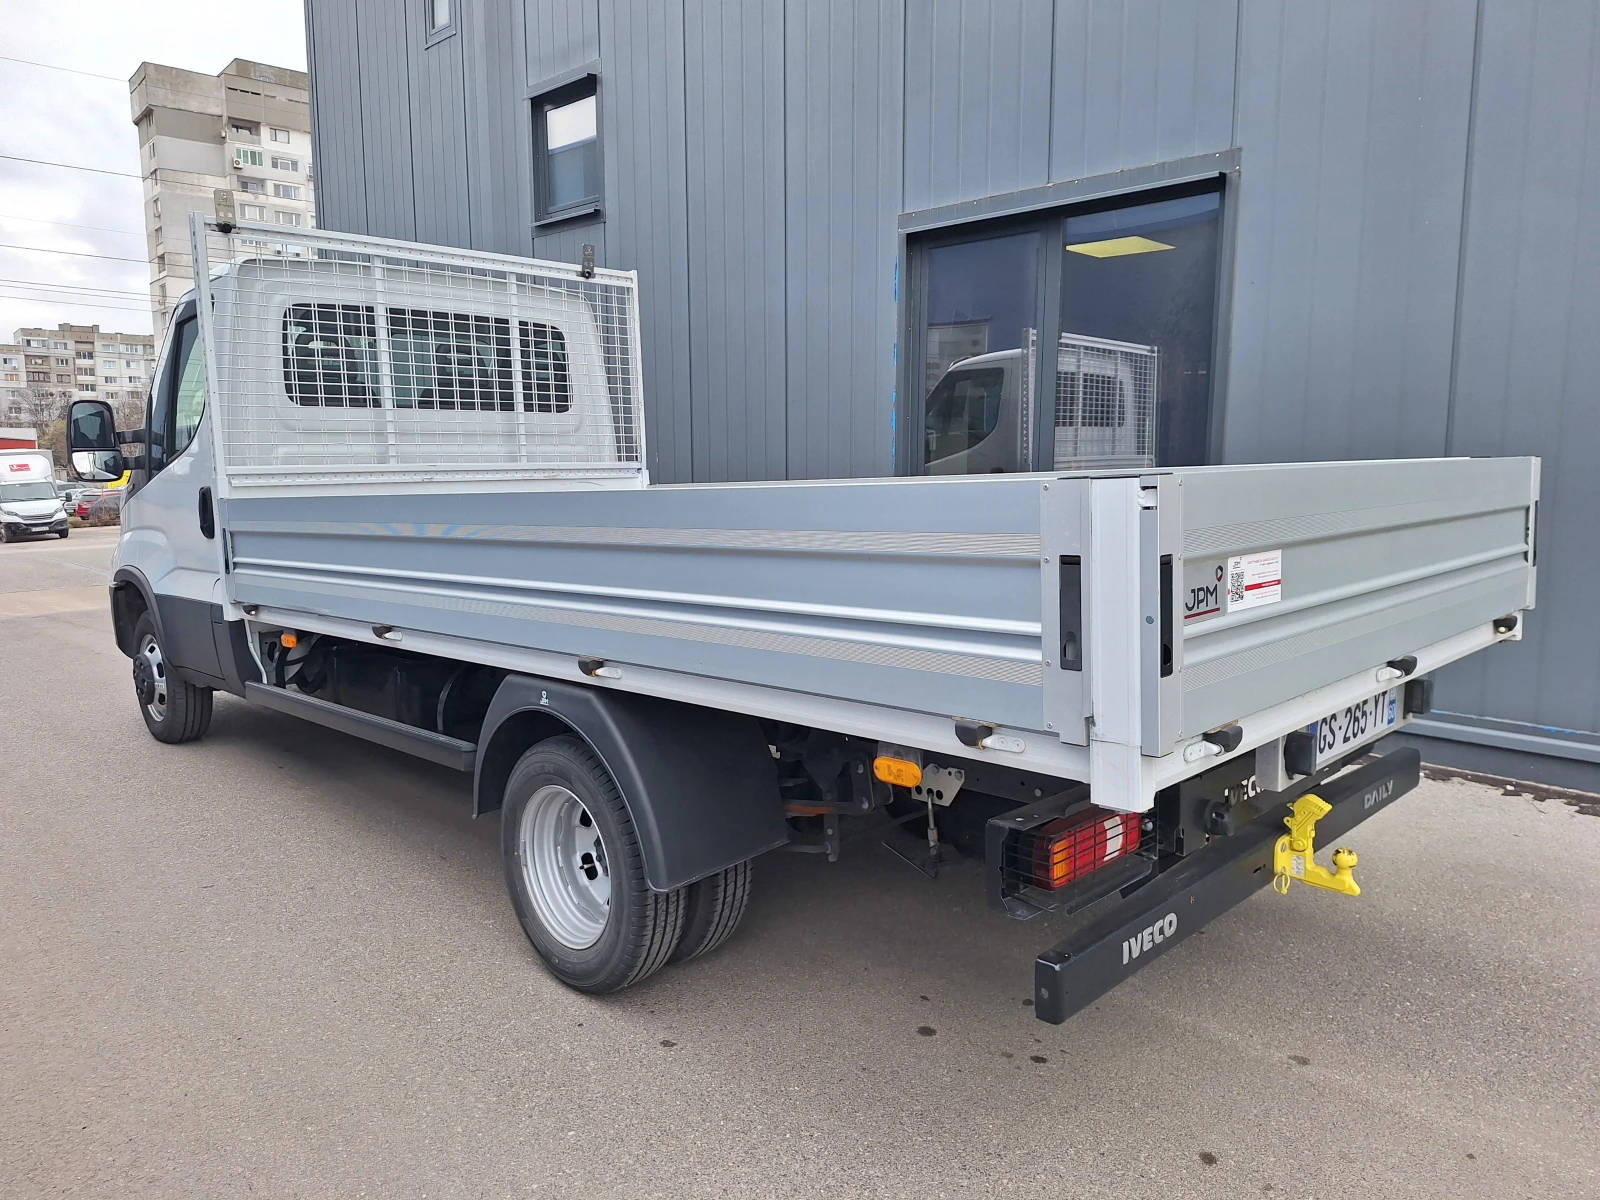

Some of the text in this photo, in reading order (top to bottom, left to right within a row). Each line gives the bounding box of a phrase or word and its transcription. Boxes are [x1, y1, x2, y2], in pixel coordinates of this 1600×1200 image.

[1185, 583, 1218, 612] JPM
[1318, 690, 1388, 755] GS-265-YT
[1224, 774, 1264, 806] IVEC
[1364, 779, 1394, 810] DAILY
[1122, 912, 1178, 965] IVECO
